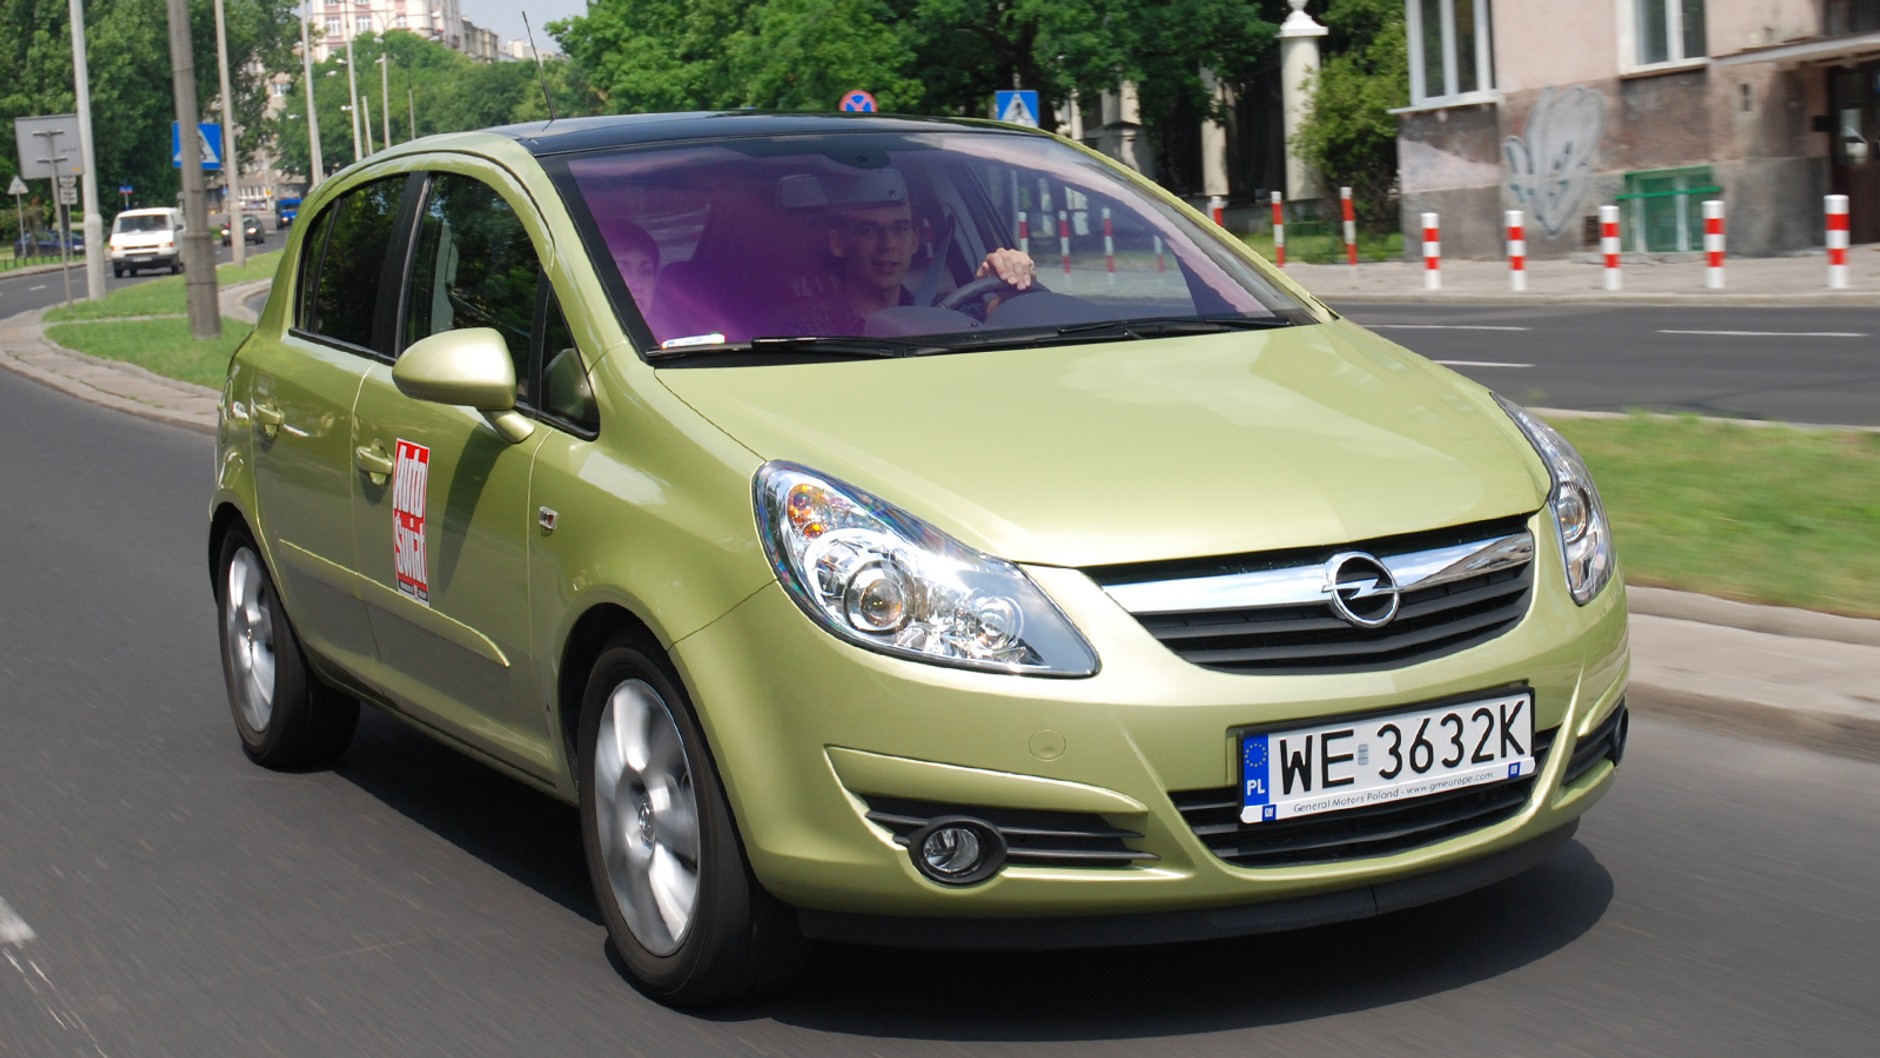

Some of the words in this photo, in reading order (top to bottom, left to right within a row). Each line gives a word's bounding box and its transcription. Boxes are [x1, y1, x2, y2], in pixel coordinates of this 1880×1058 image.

[393, 444, 427, 518] Auto
[1280, 729, 1355, 795] WE
[1377, 700, 1526, 780] 3632K
[1246, 778, 1266, 796] PL
[1293, 800, 1331, 813] General
[1332, 795, 1365, 807] Motors
[1366, 788, 1399, 801] Poland
[1406, 771, 1494, 794] www.gmeurope.com
